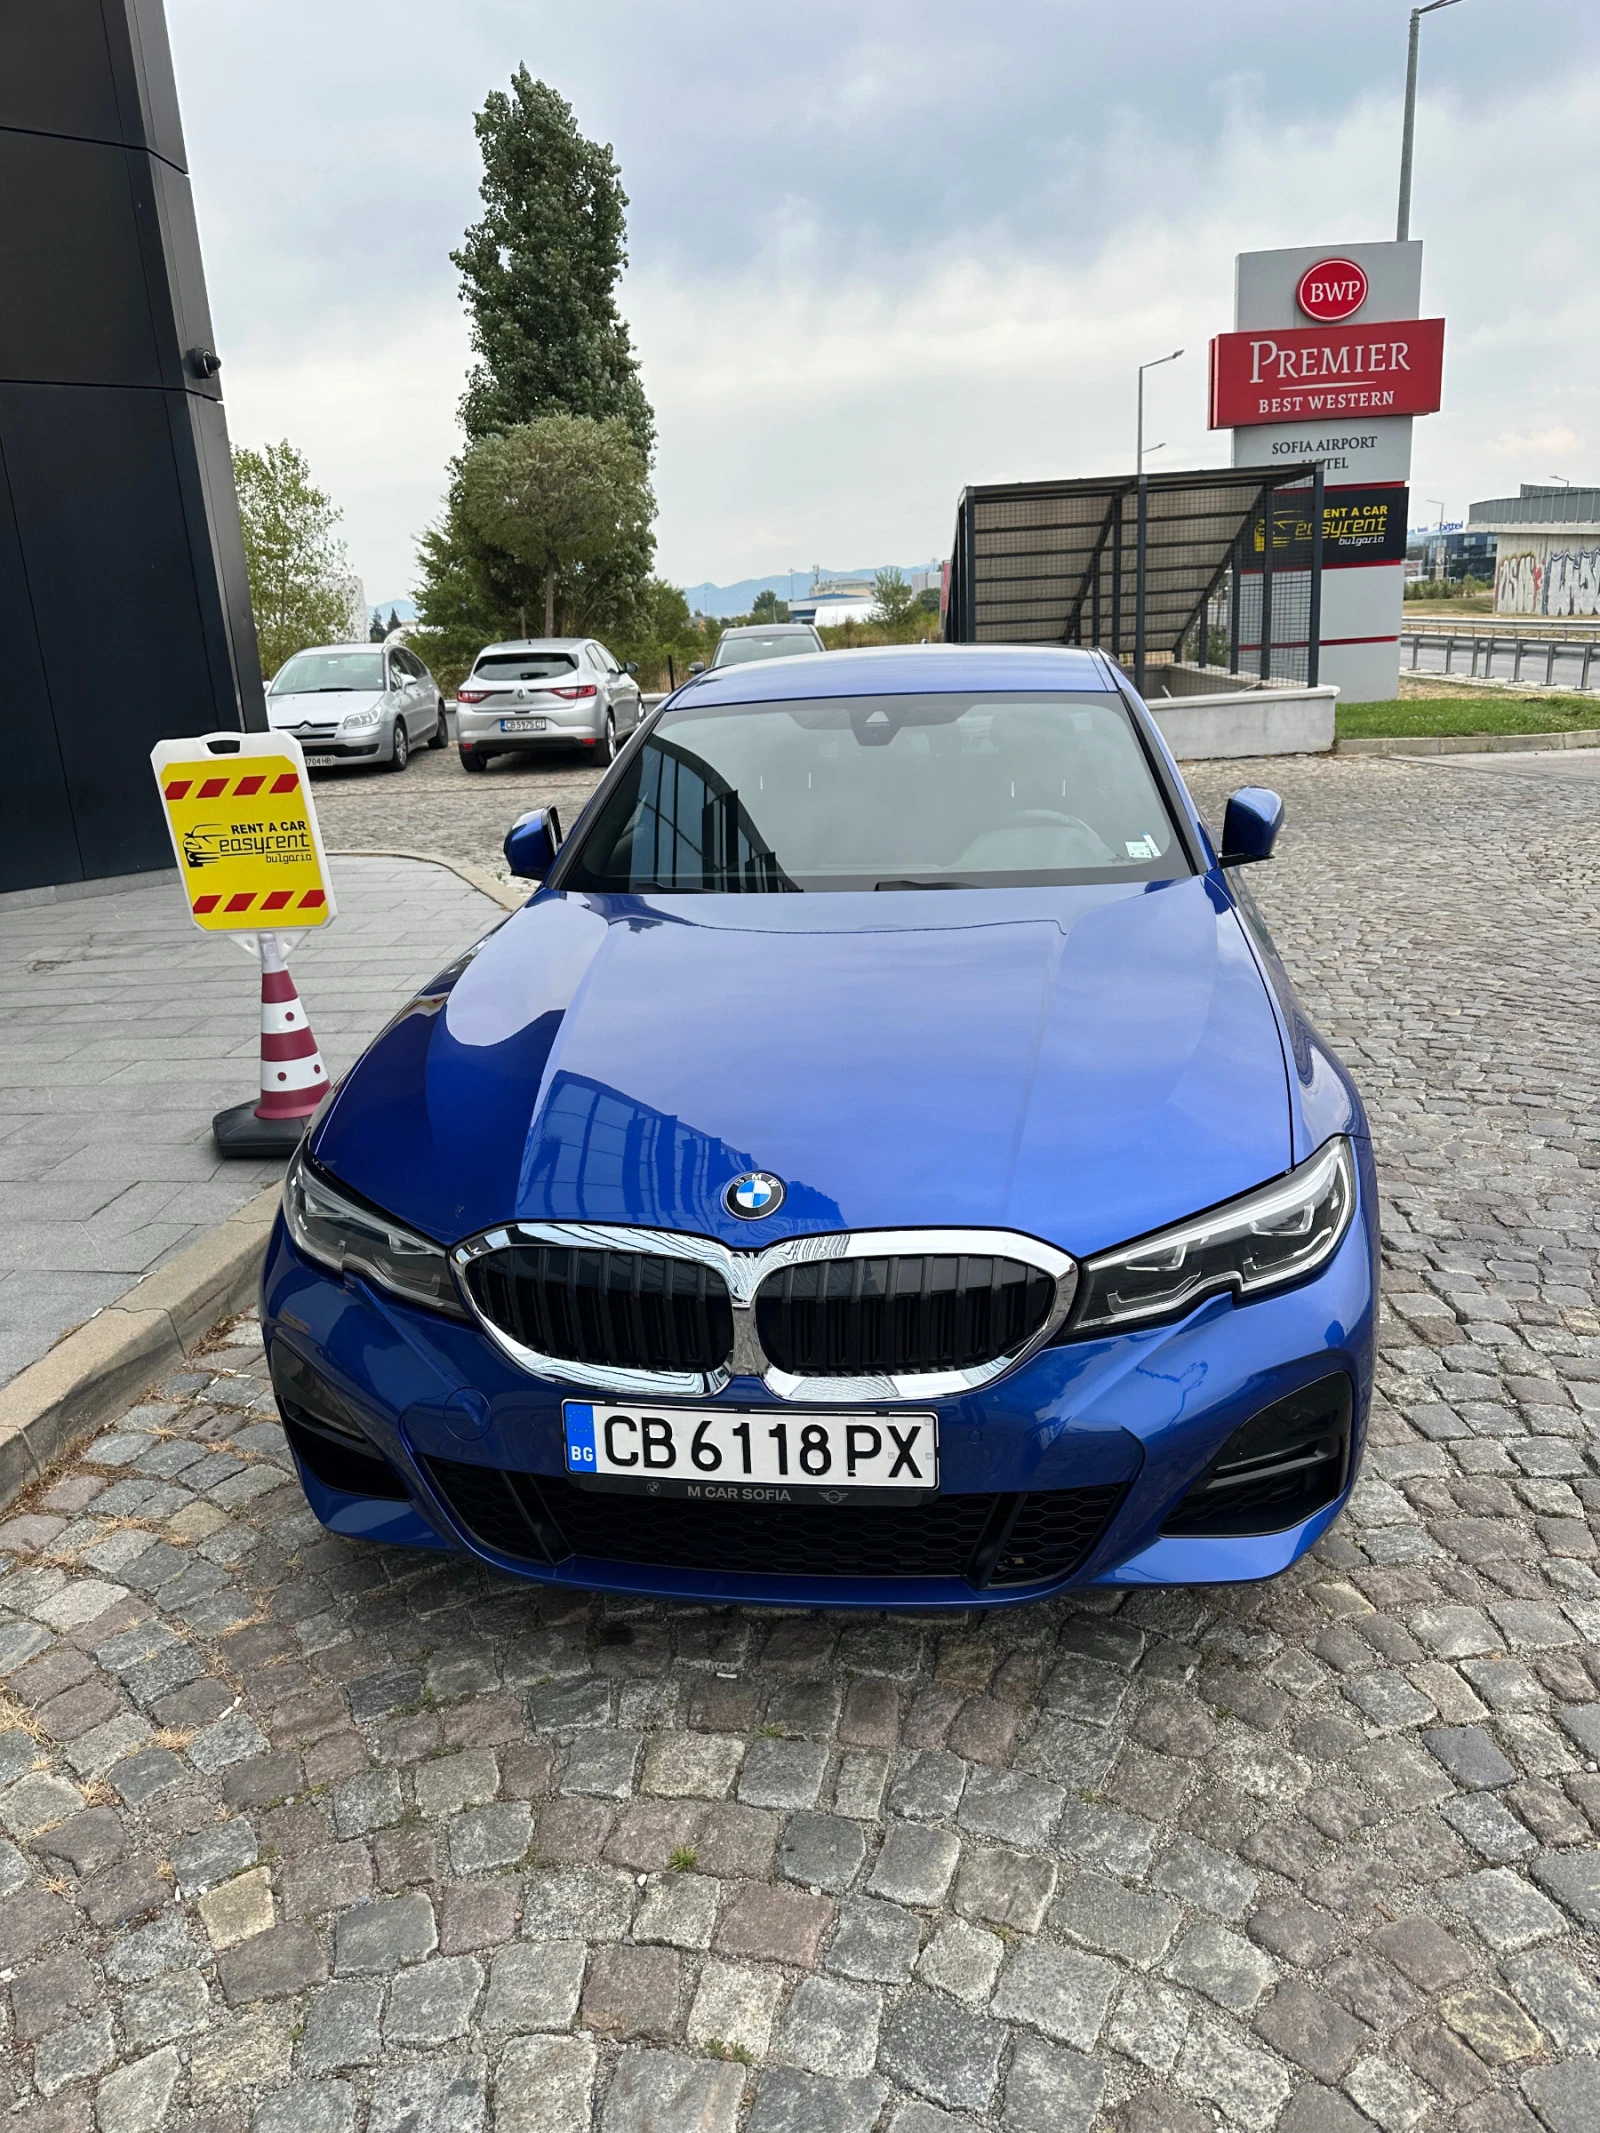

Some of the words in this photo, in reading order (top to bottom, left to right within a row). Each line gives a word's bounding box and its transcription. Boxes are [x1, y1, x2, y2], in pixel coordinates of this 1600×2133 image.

[1309, 280, 1361, 303] BWP
[1249, 340, 1411, 384] PREMIER
[1258, 397, 1303, 414] BEST
[1308, 390, 1395, 410] WESTERN
[1272, 440, 1314, 455] SOFIA
[1316, 436, 1378, 452] AIRPORT
[1302, 457, 1349, 470] TEL
[1323, 508, 1348, 519] ENT
[1351, 507, 1360, 517] A
[1363, 505, 1388, 516] CAR
[1338, 536, 1385, 547] bulgaria
[231, 823, 264, 835] RENT
[269, 822, 278, 832] A
[280, 820, 307, 832] CAR
[219, 832, 310, 855] easyrent
[266, 853, 312, 865] bulgaria
[734, 1173, 781, 1187] BMW
[571, 1446, 594, 1463] BG
[687, 1485, 700, 1497] M
[704, 1486, 738, 1499] CAR
[742, 1488, 792, 1501] SOFIA
